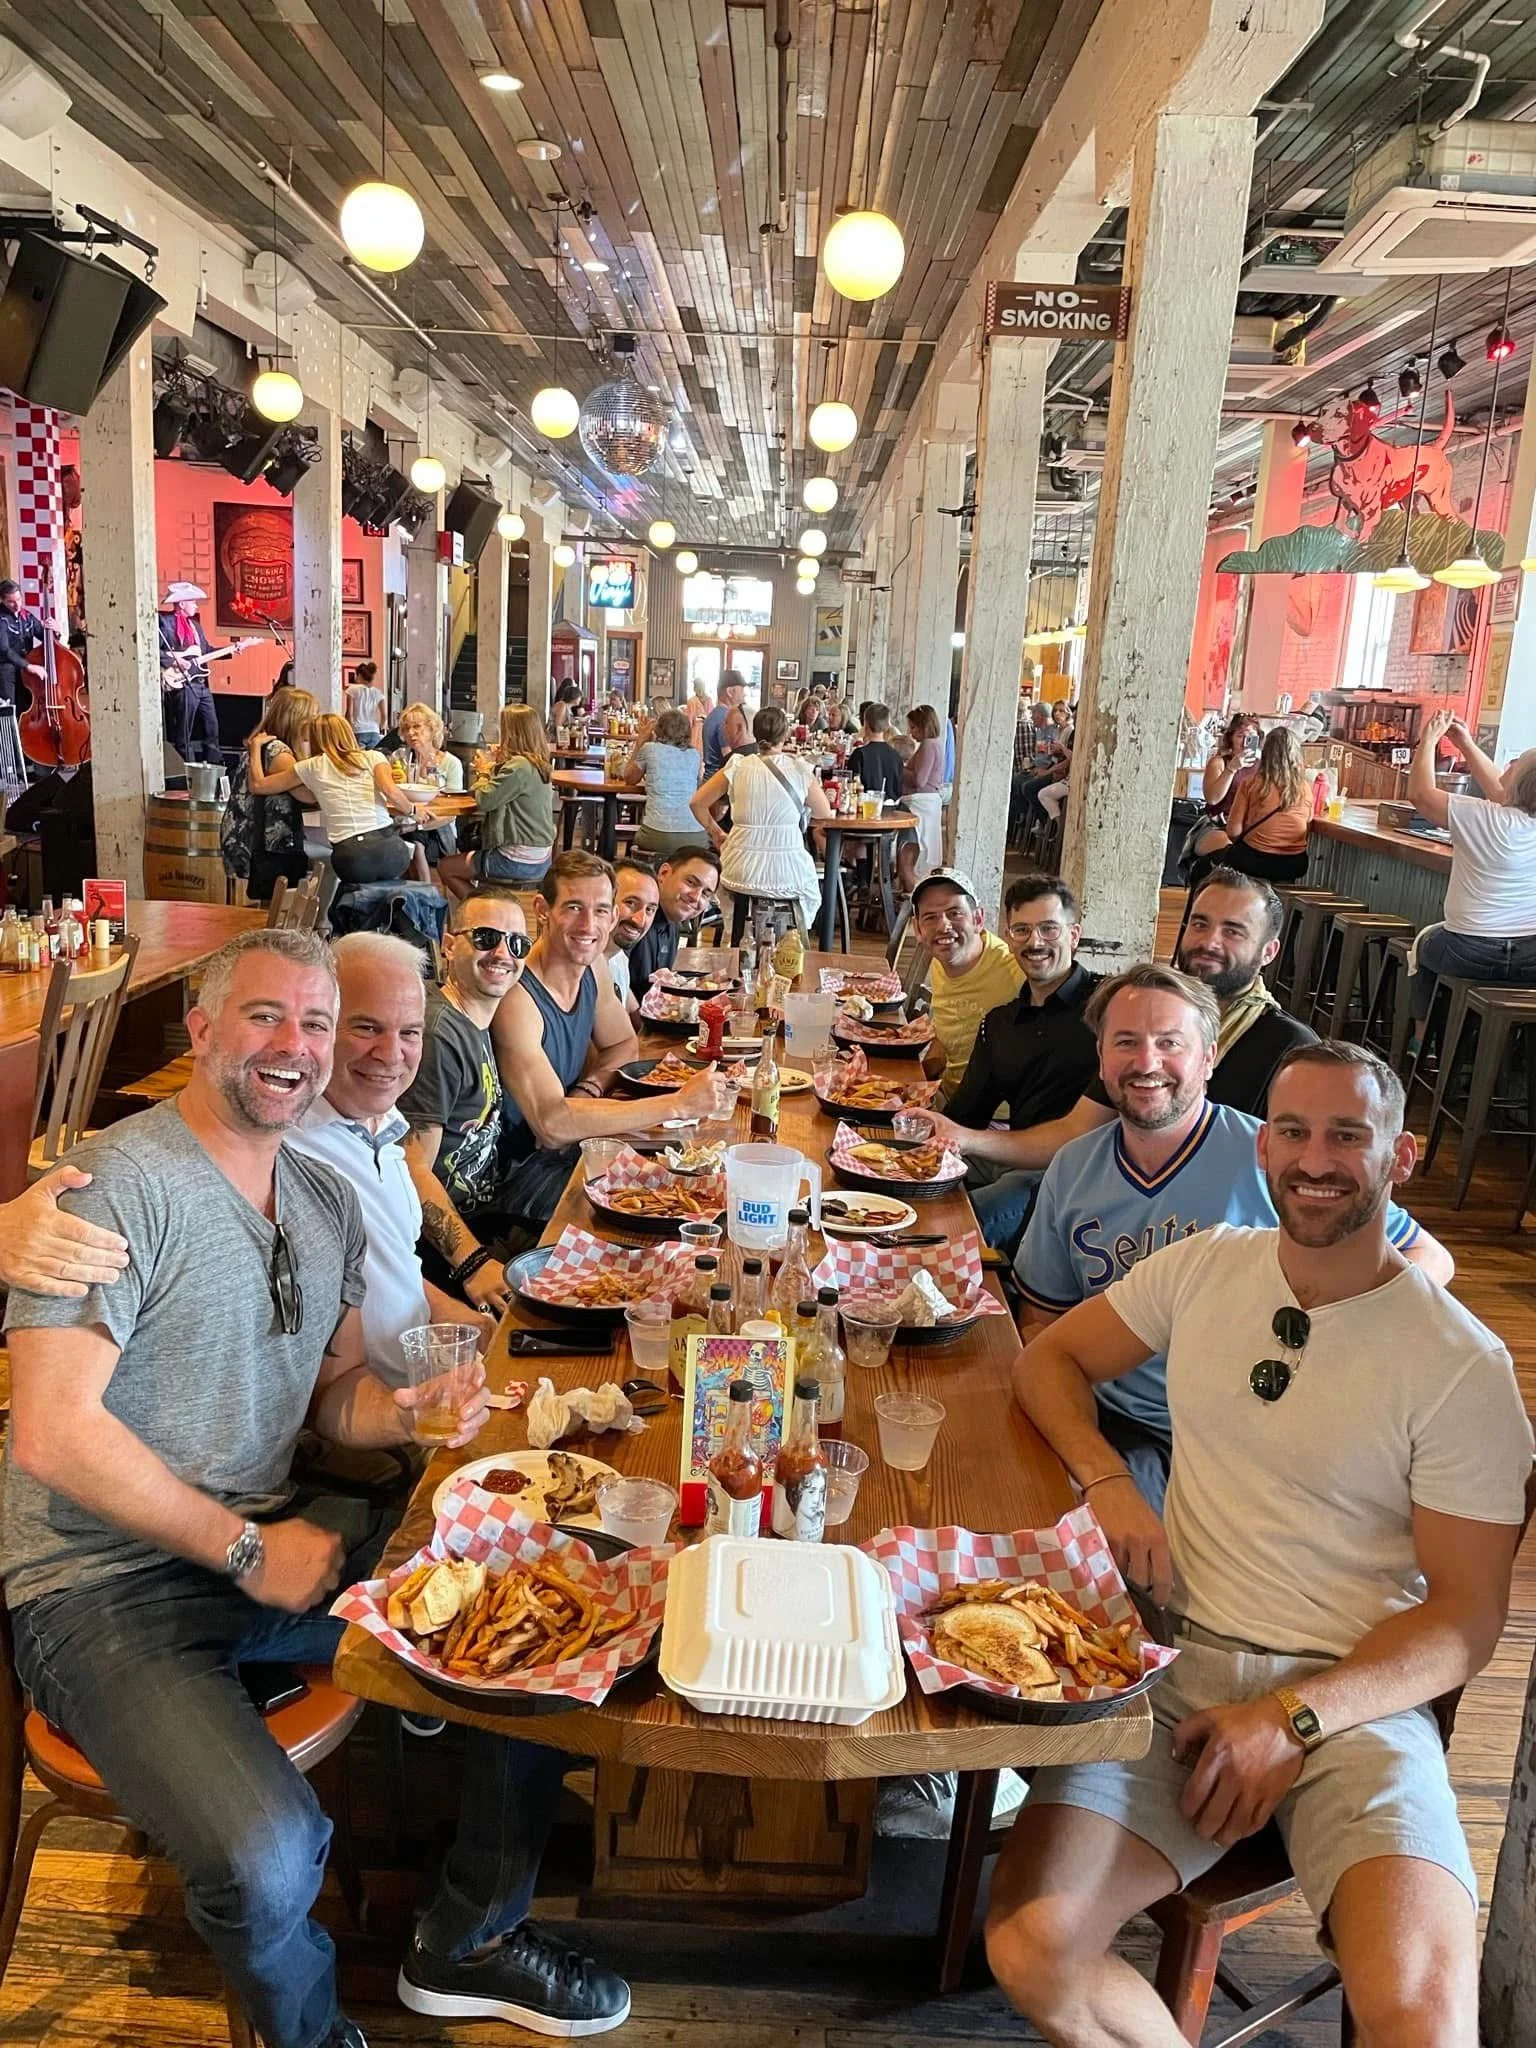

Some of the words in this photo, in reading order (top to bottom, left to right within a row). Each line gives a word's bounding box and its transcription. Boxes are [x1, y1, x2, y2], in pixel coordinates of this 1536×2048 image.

[1000, 309, 1112, 331] SMOKING
[1395, 750, 1407, 759] 130
[743, 1202, 770, 1214] BUD
[738, 1210, 776, 1224] LIGHT
[1072, 1213, 1216, 1287] Seat
